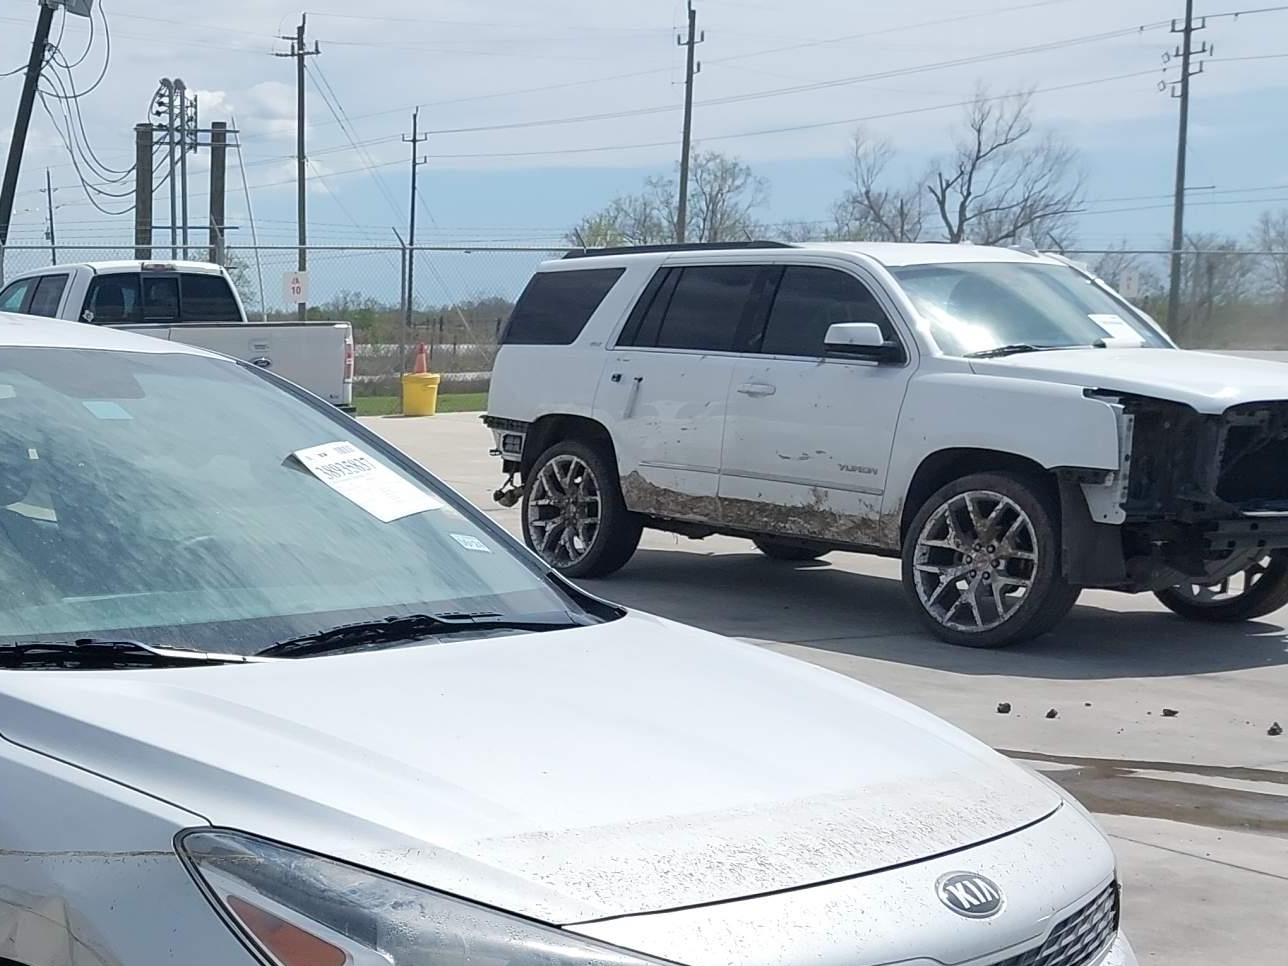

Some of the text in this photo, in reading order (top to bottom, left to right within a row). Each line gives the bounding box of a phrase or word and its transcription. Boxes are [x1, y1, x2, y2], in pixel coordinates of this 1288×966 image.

[291, 286, 302, 295] 10
[837, 463, 879, 476] YUKON
[945, 877, 1000, 910] KIA
